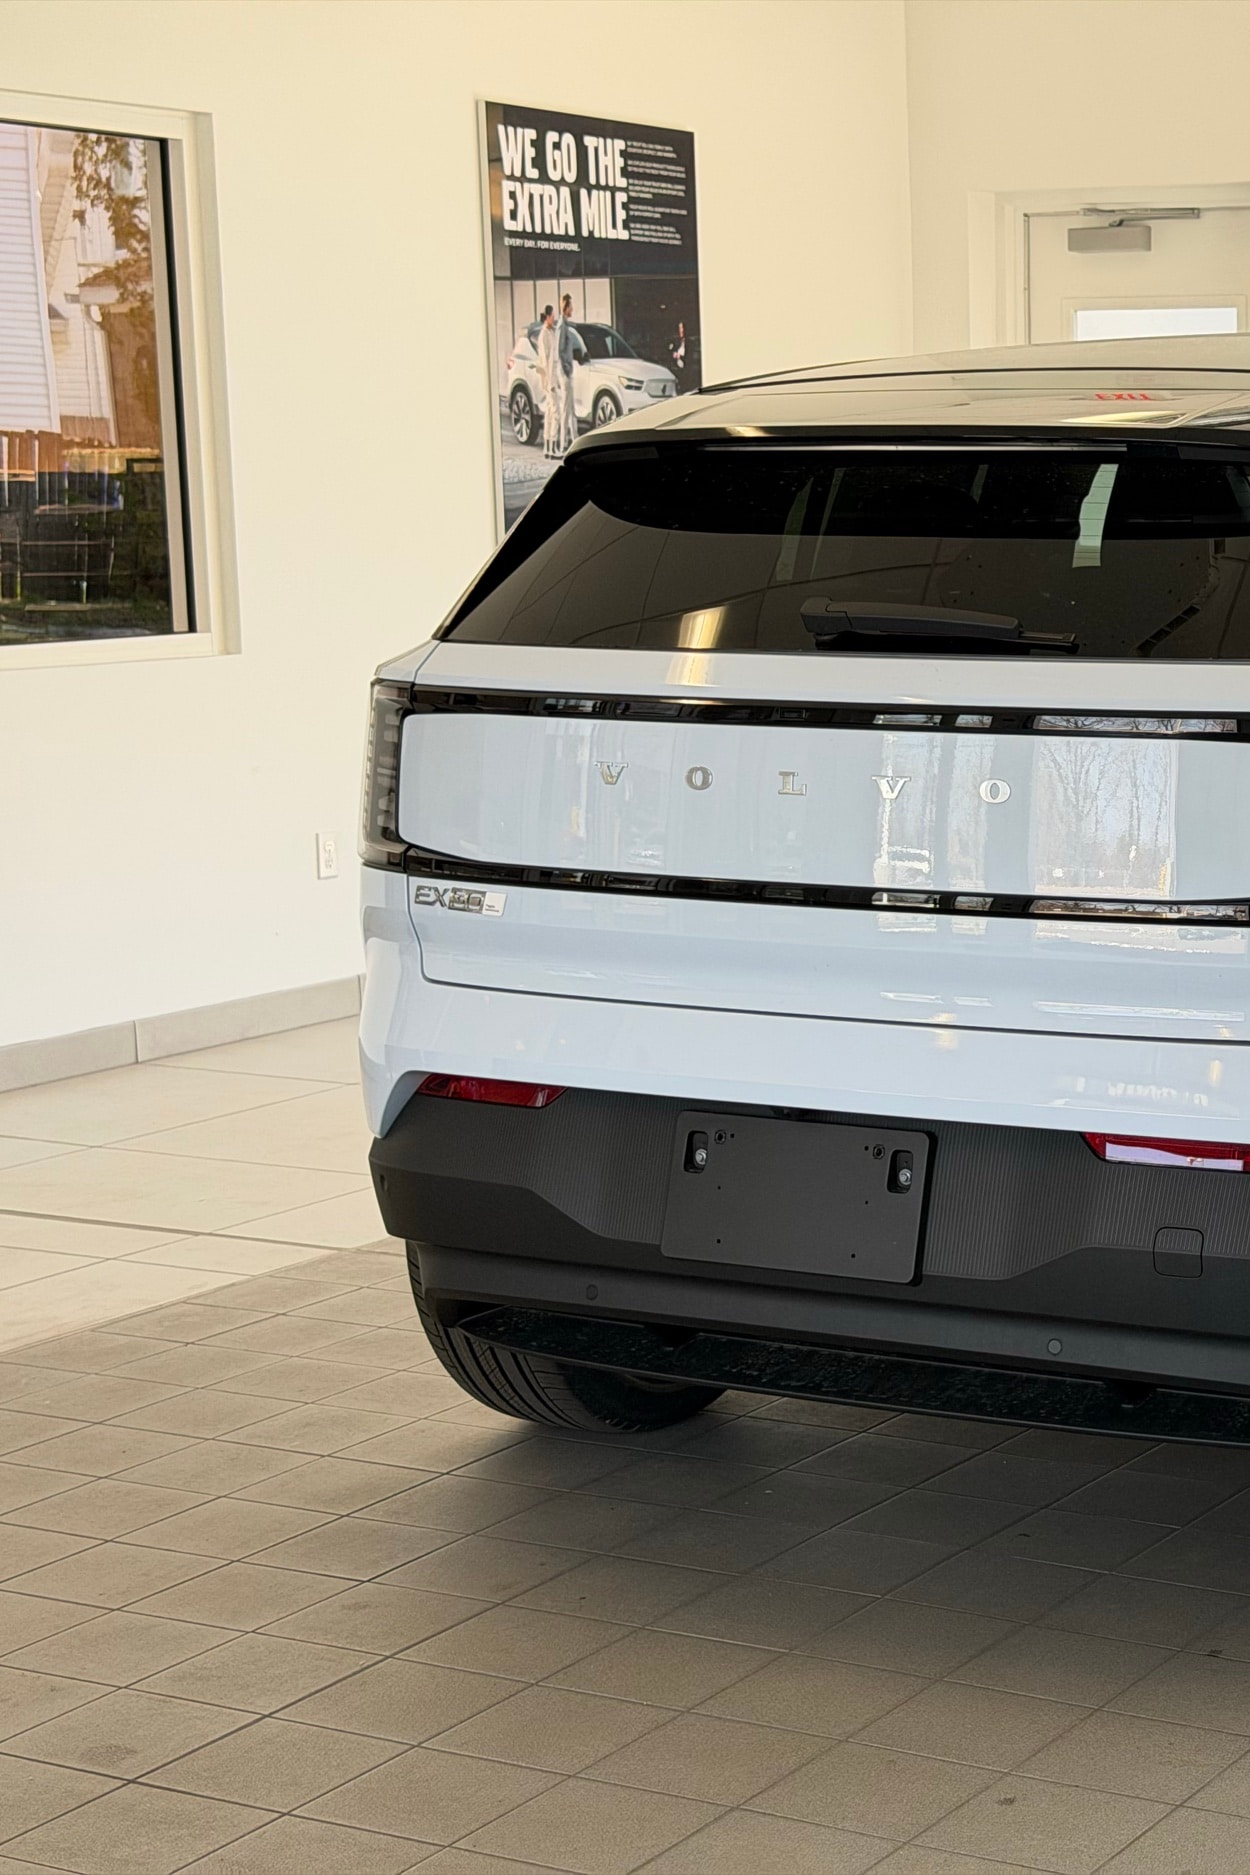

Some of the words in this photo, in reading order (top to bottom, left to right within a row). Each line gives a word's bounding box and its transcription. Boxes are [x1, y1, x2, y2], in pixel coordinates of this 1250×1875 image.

[497, 124, 539, 179] WE
[545, 130, 577, 183] GO
[583, 135, 627, 188] THE
[502, 180, 575, 236] EXTRA
[580, 187, 630, 240] MILE
[504, 236, 523, 247] EVERY
[537, 240, 549, 249] FOR
[549, 241, 581, 251] EVERYONE.
[593, 760, 1012, 805] VOLVO
